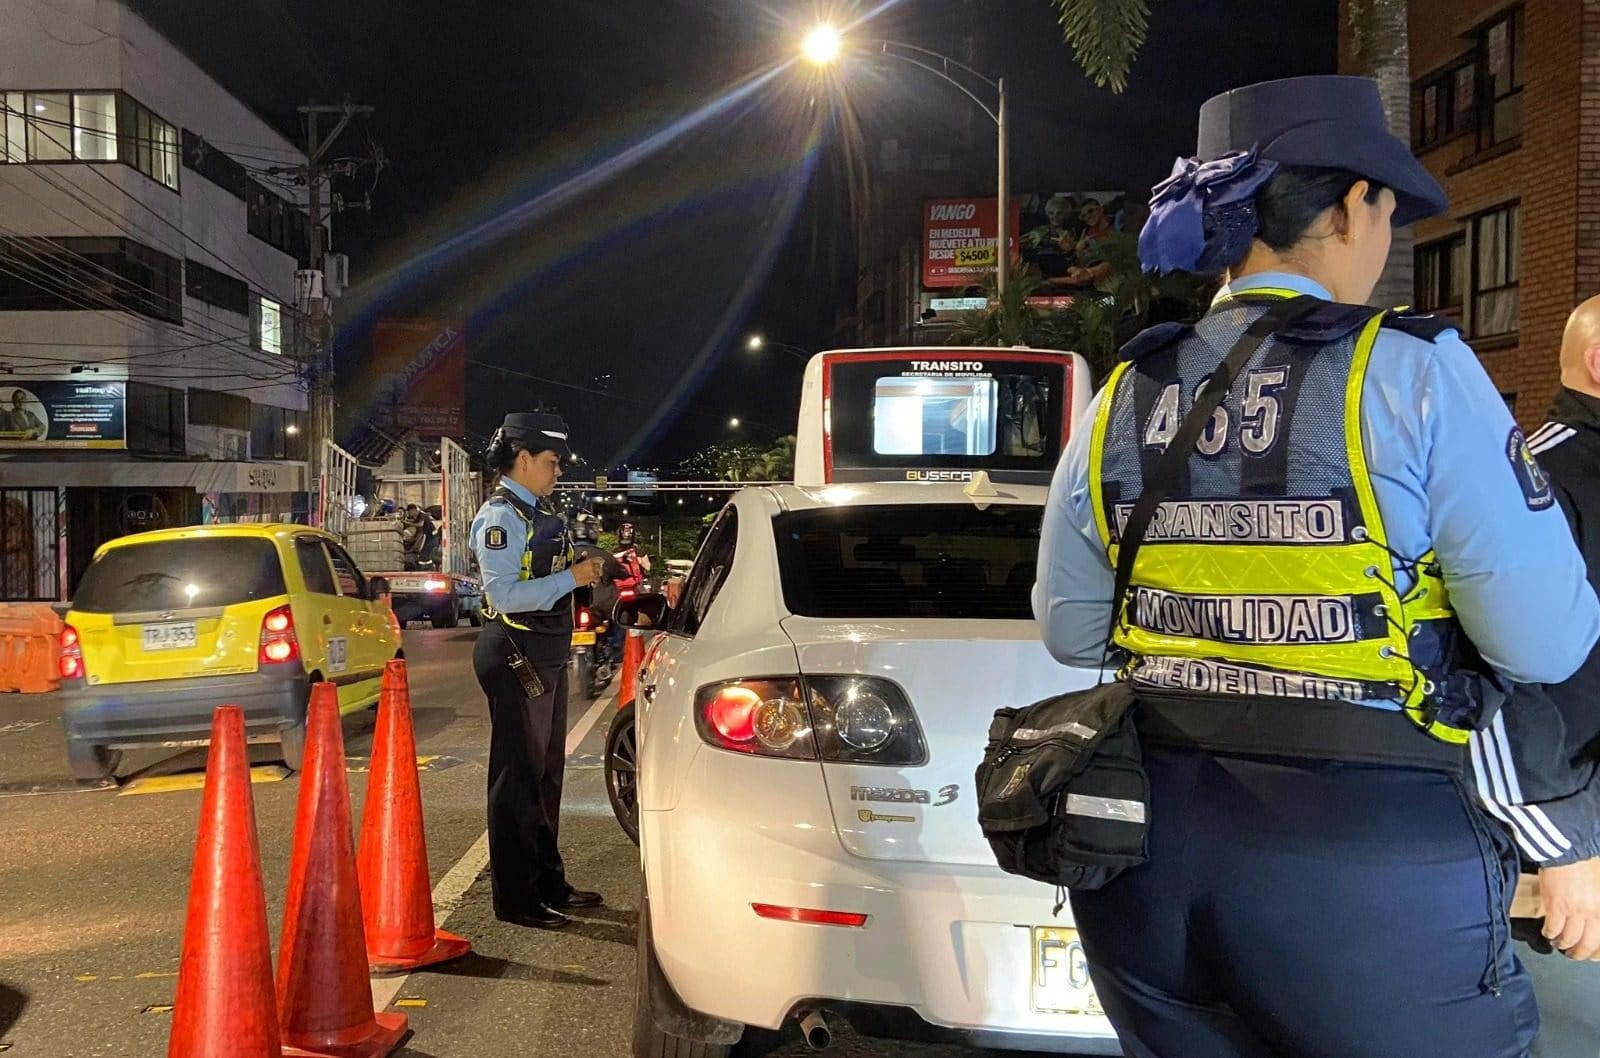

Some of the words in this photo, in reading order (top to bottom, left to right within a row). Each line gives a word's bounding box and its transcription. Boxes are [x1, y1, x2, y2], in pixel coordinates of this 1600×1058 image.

[930, 204, 976, 220] YANGO
[929, 249, 955, 260] DESDE
[960, 250, 989, 262] $4500
[911, 361, 983, 371] TRANSITO
[906, 470, 973, 480] BUSSCA
[1138, 589, 1350, 643] MOVILIDAD
[932, 784, 960, 807] 3
[1038, 939, 1090, 989] FG
